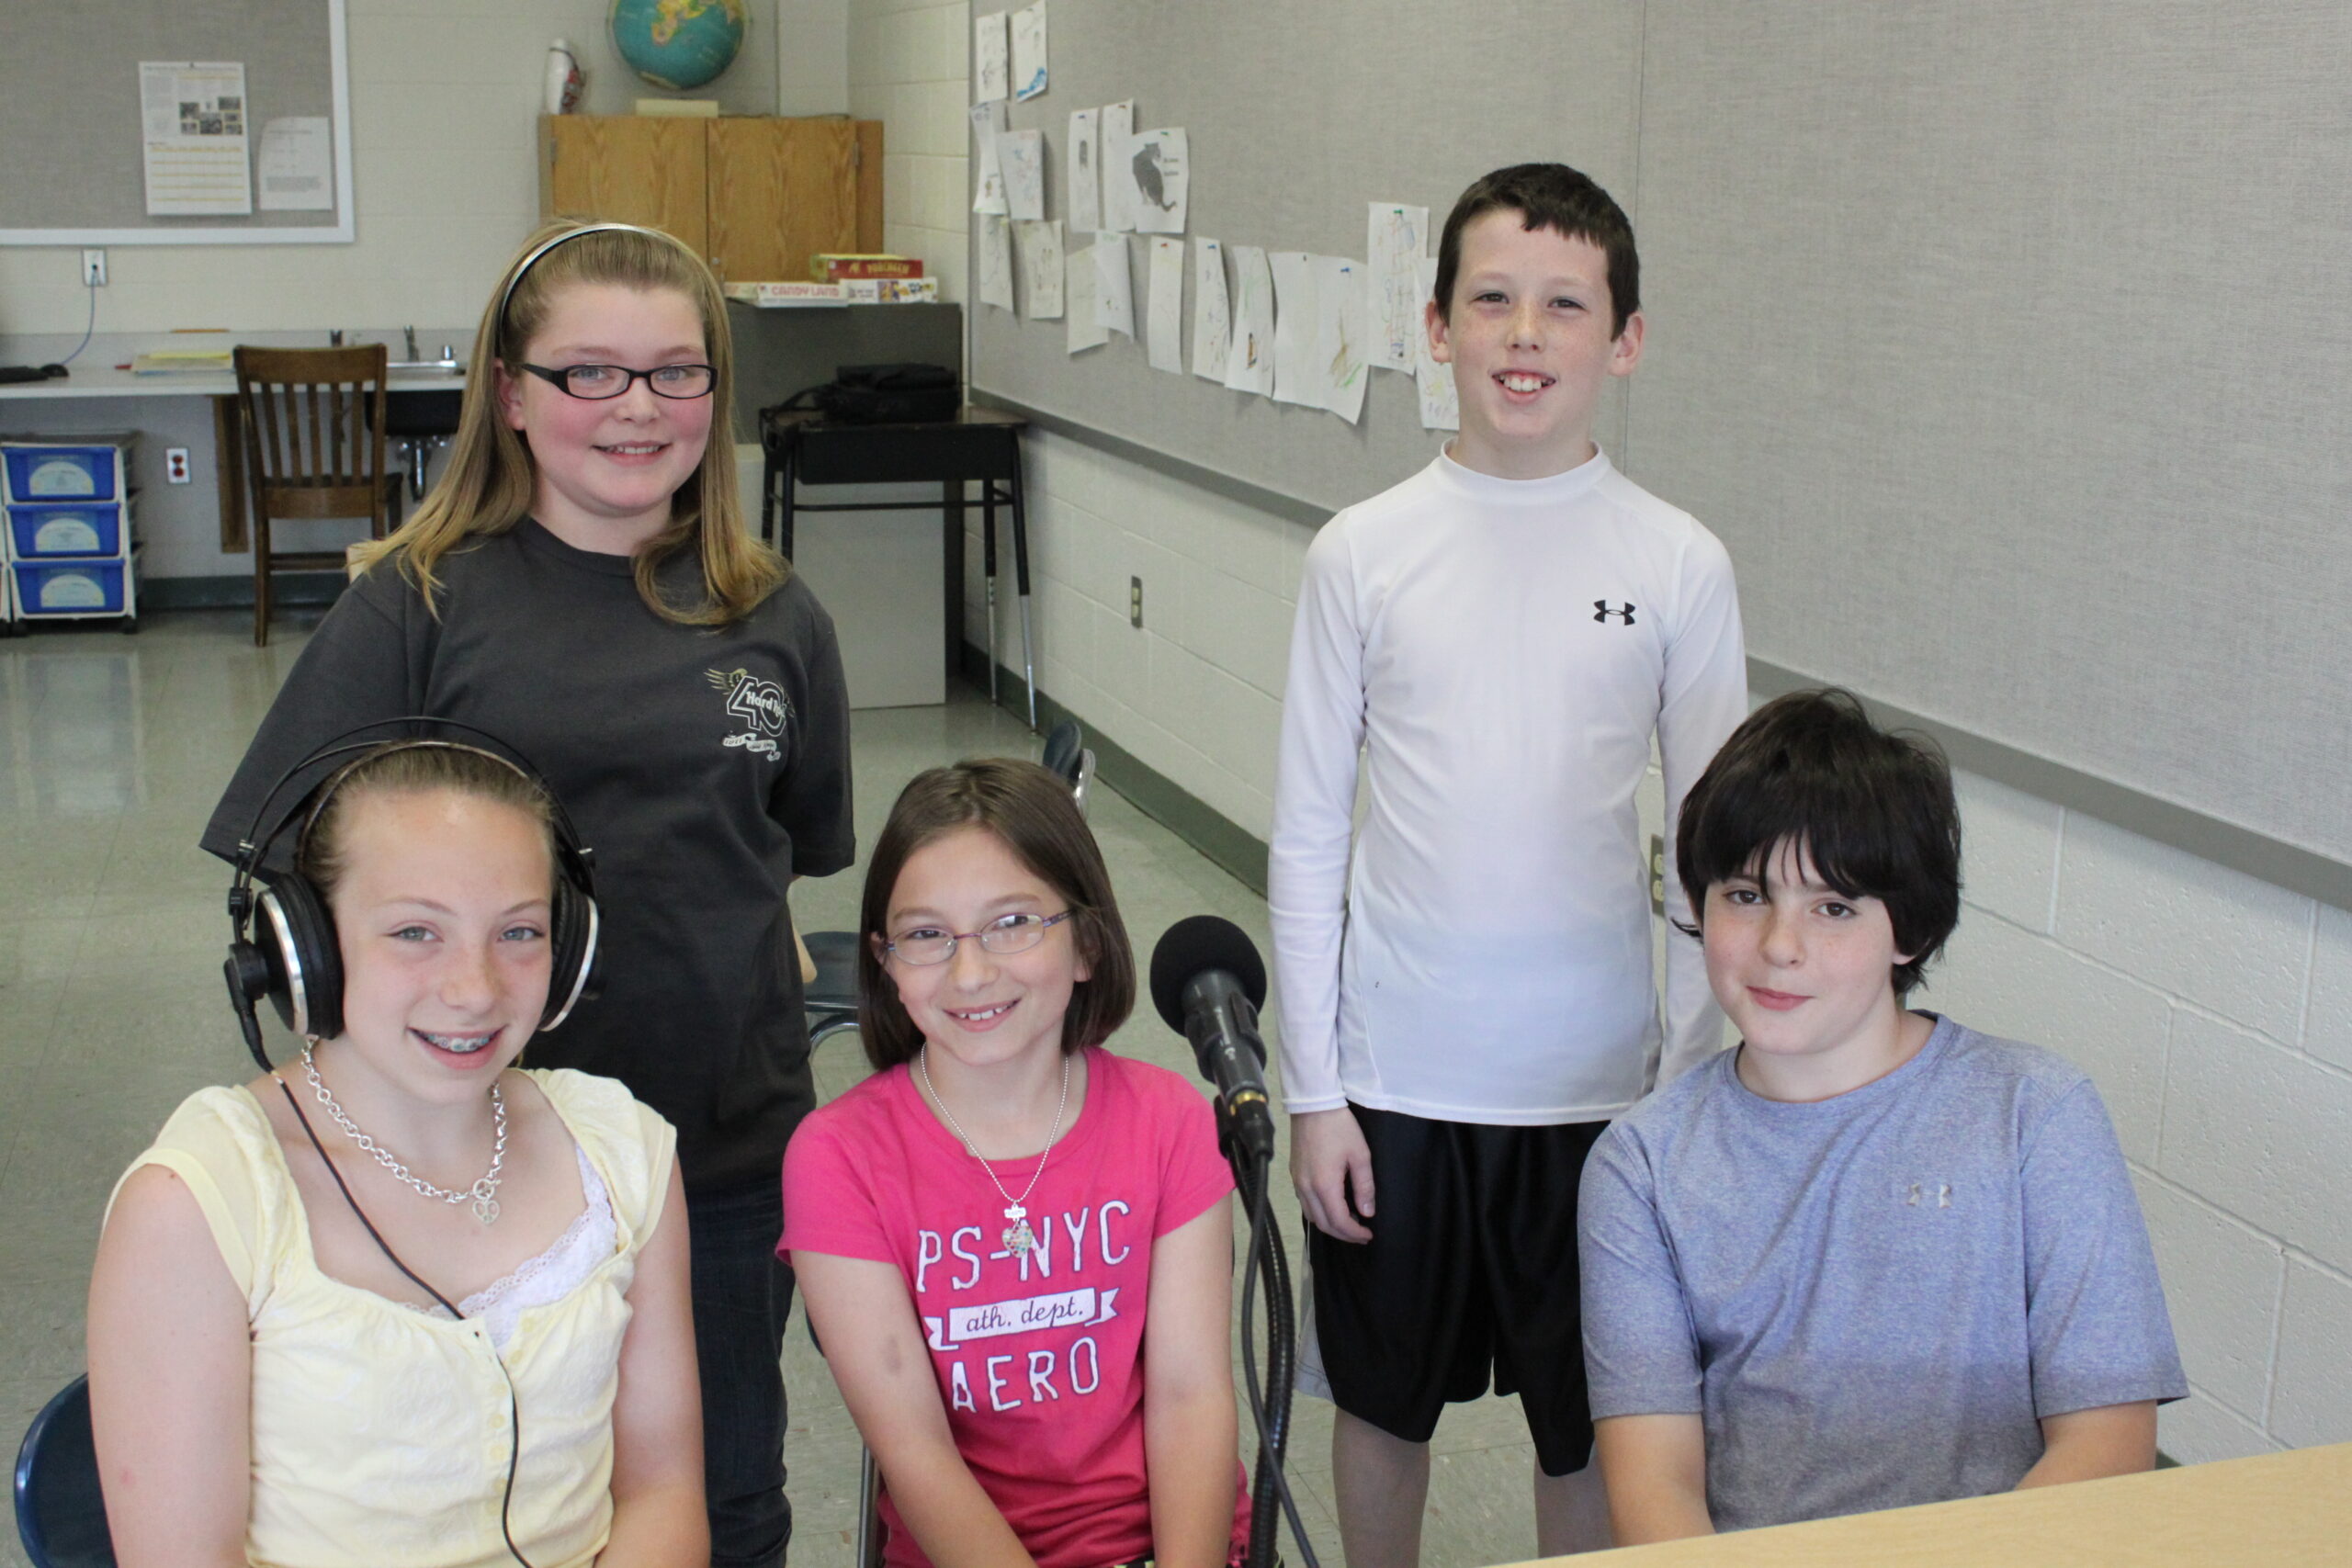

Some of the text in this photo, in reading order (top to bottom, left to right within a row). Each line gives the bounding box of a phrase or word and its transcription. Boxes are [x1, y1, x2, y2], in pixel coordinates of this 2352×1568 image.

[771, 286, 808, 296] CANDY
[811, 286, 840, 298] LAND
[746, 691, 774, 711] Hard
[967, 1296, 1083, 1332] ath. dept.
[952, 1337, 1100, 1413] AERO
